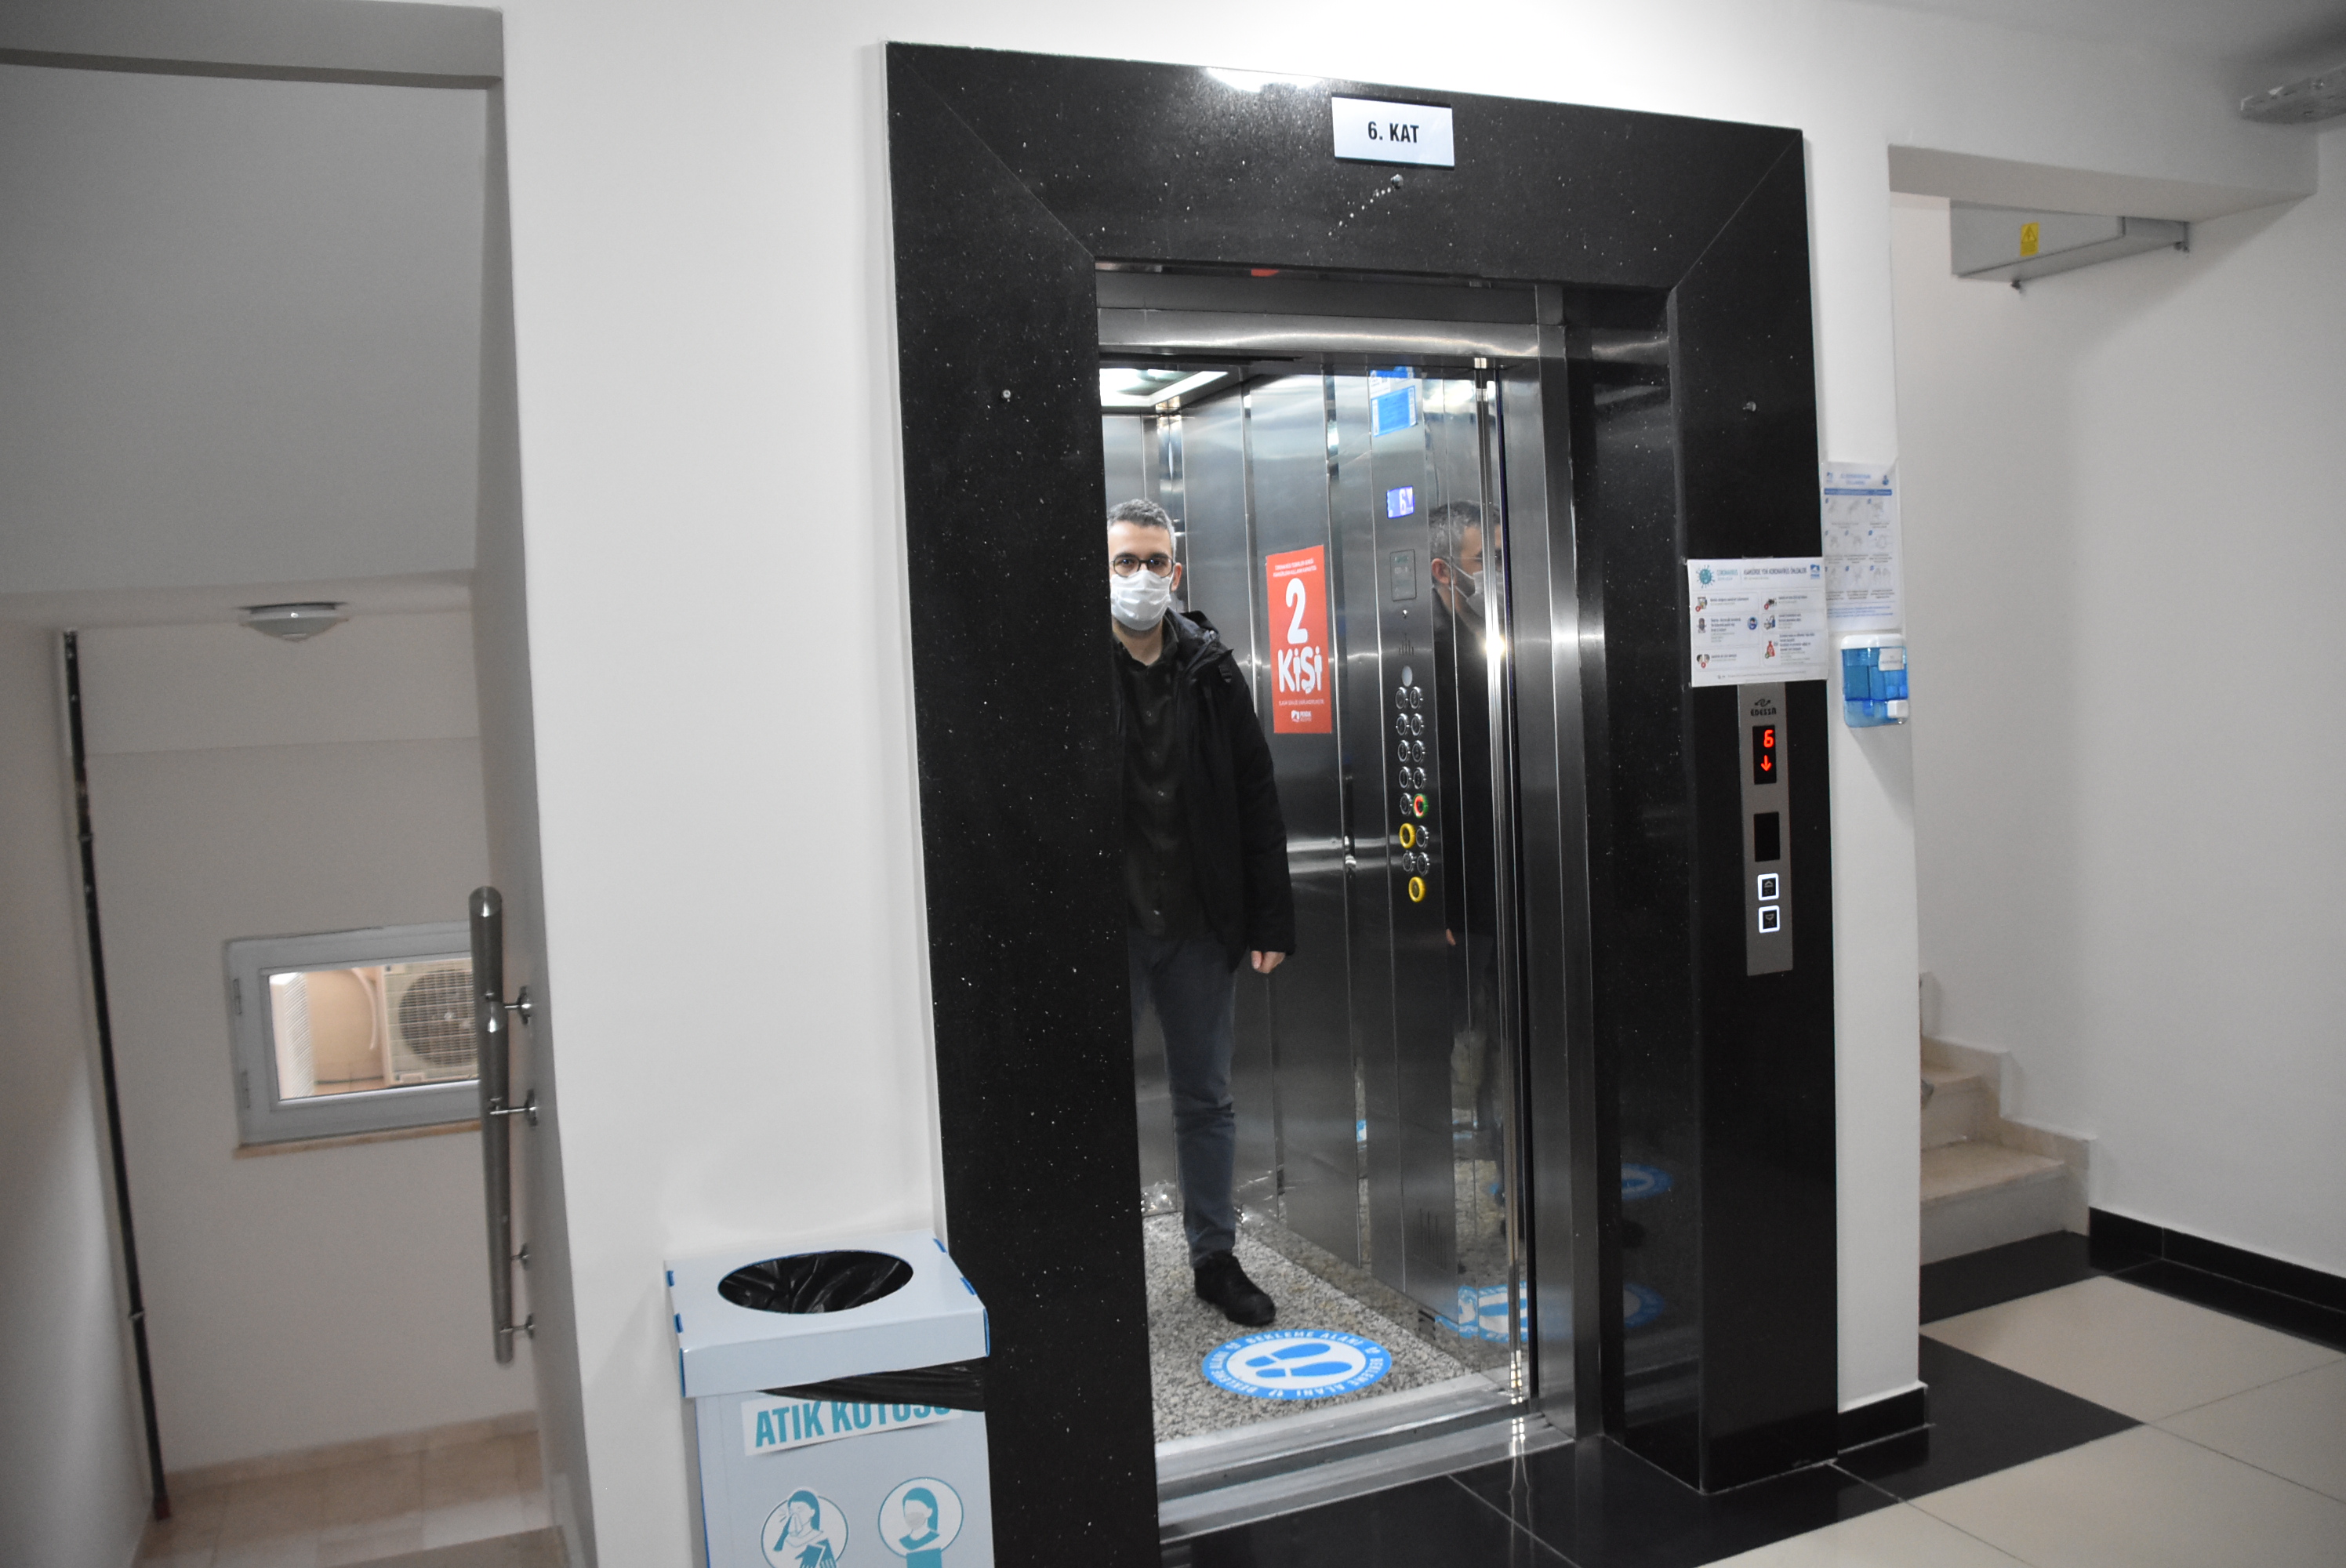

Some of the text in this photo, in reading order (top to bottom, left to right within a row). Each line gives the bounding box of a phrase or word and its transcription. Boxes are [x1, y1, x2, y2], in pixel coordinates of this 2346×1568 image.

[1367, 121, 1419, 143] 6. KAT
[1399, 488, 1407, 516] 6
[1285, 577, 1309, 644] 2
[1763, 728, 1774, 749] 6
[1245, 1331, 1364, 1346] BEKLEME ALANI
[755, 1401, 826, 1448] ATIK
